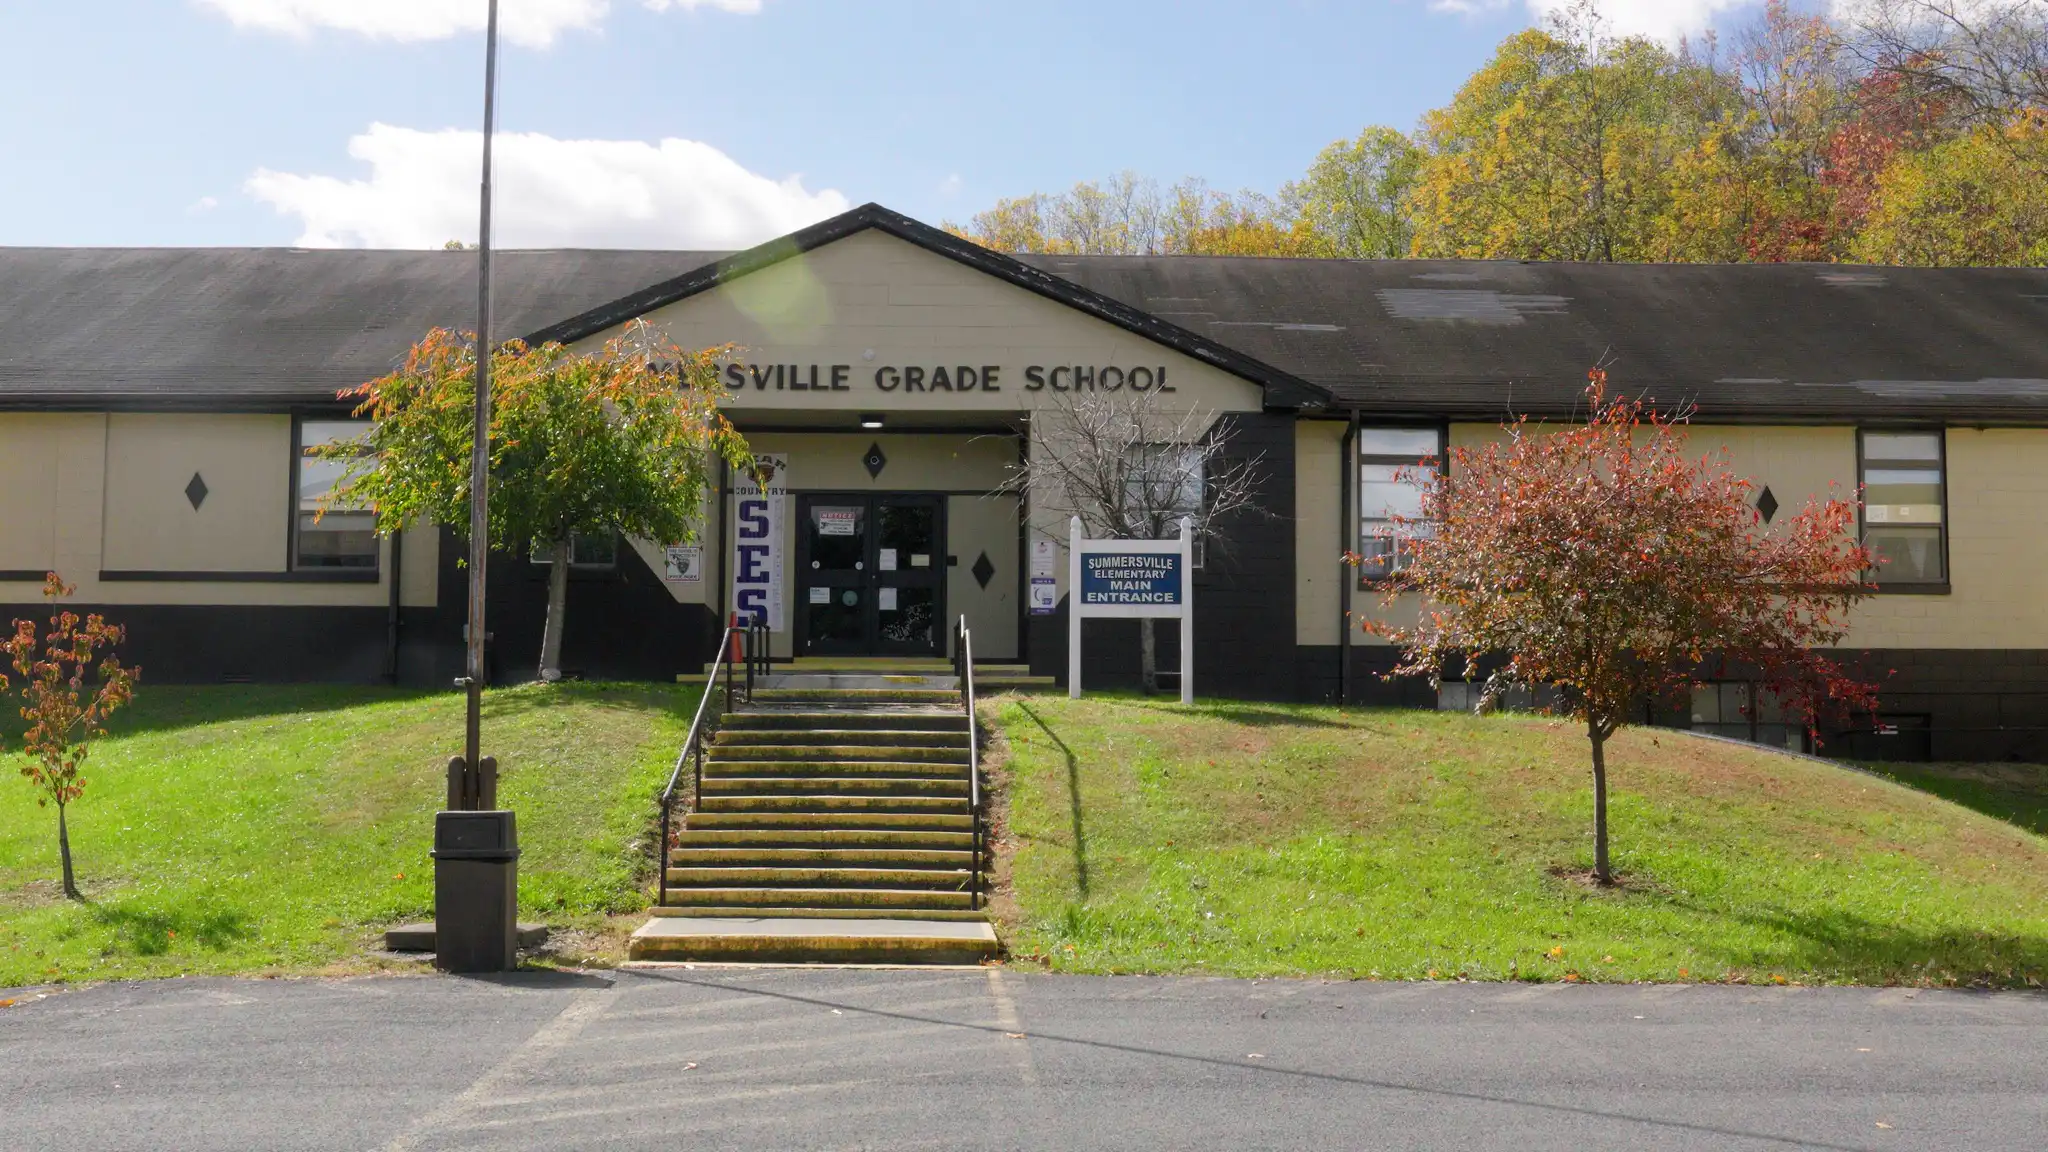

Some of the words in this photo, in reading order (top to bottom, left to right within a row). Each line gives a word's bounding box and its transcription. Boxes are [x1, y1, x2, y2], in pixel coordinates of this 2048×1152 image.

[875, 366, 1001, 392] GRADE
[1024, 365, 1177, 392] SCHOOL
[1088, 556, 1173, 570] SUMMERSVILLE
[1094, 570, 1166, 579] ELEMENTARY
[1110, 581, 1152, 590] MAIN
[1087, 592, 1174, 602] ENTRANCE
